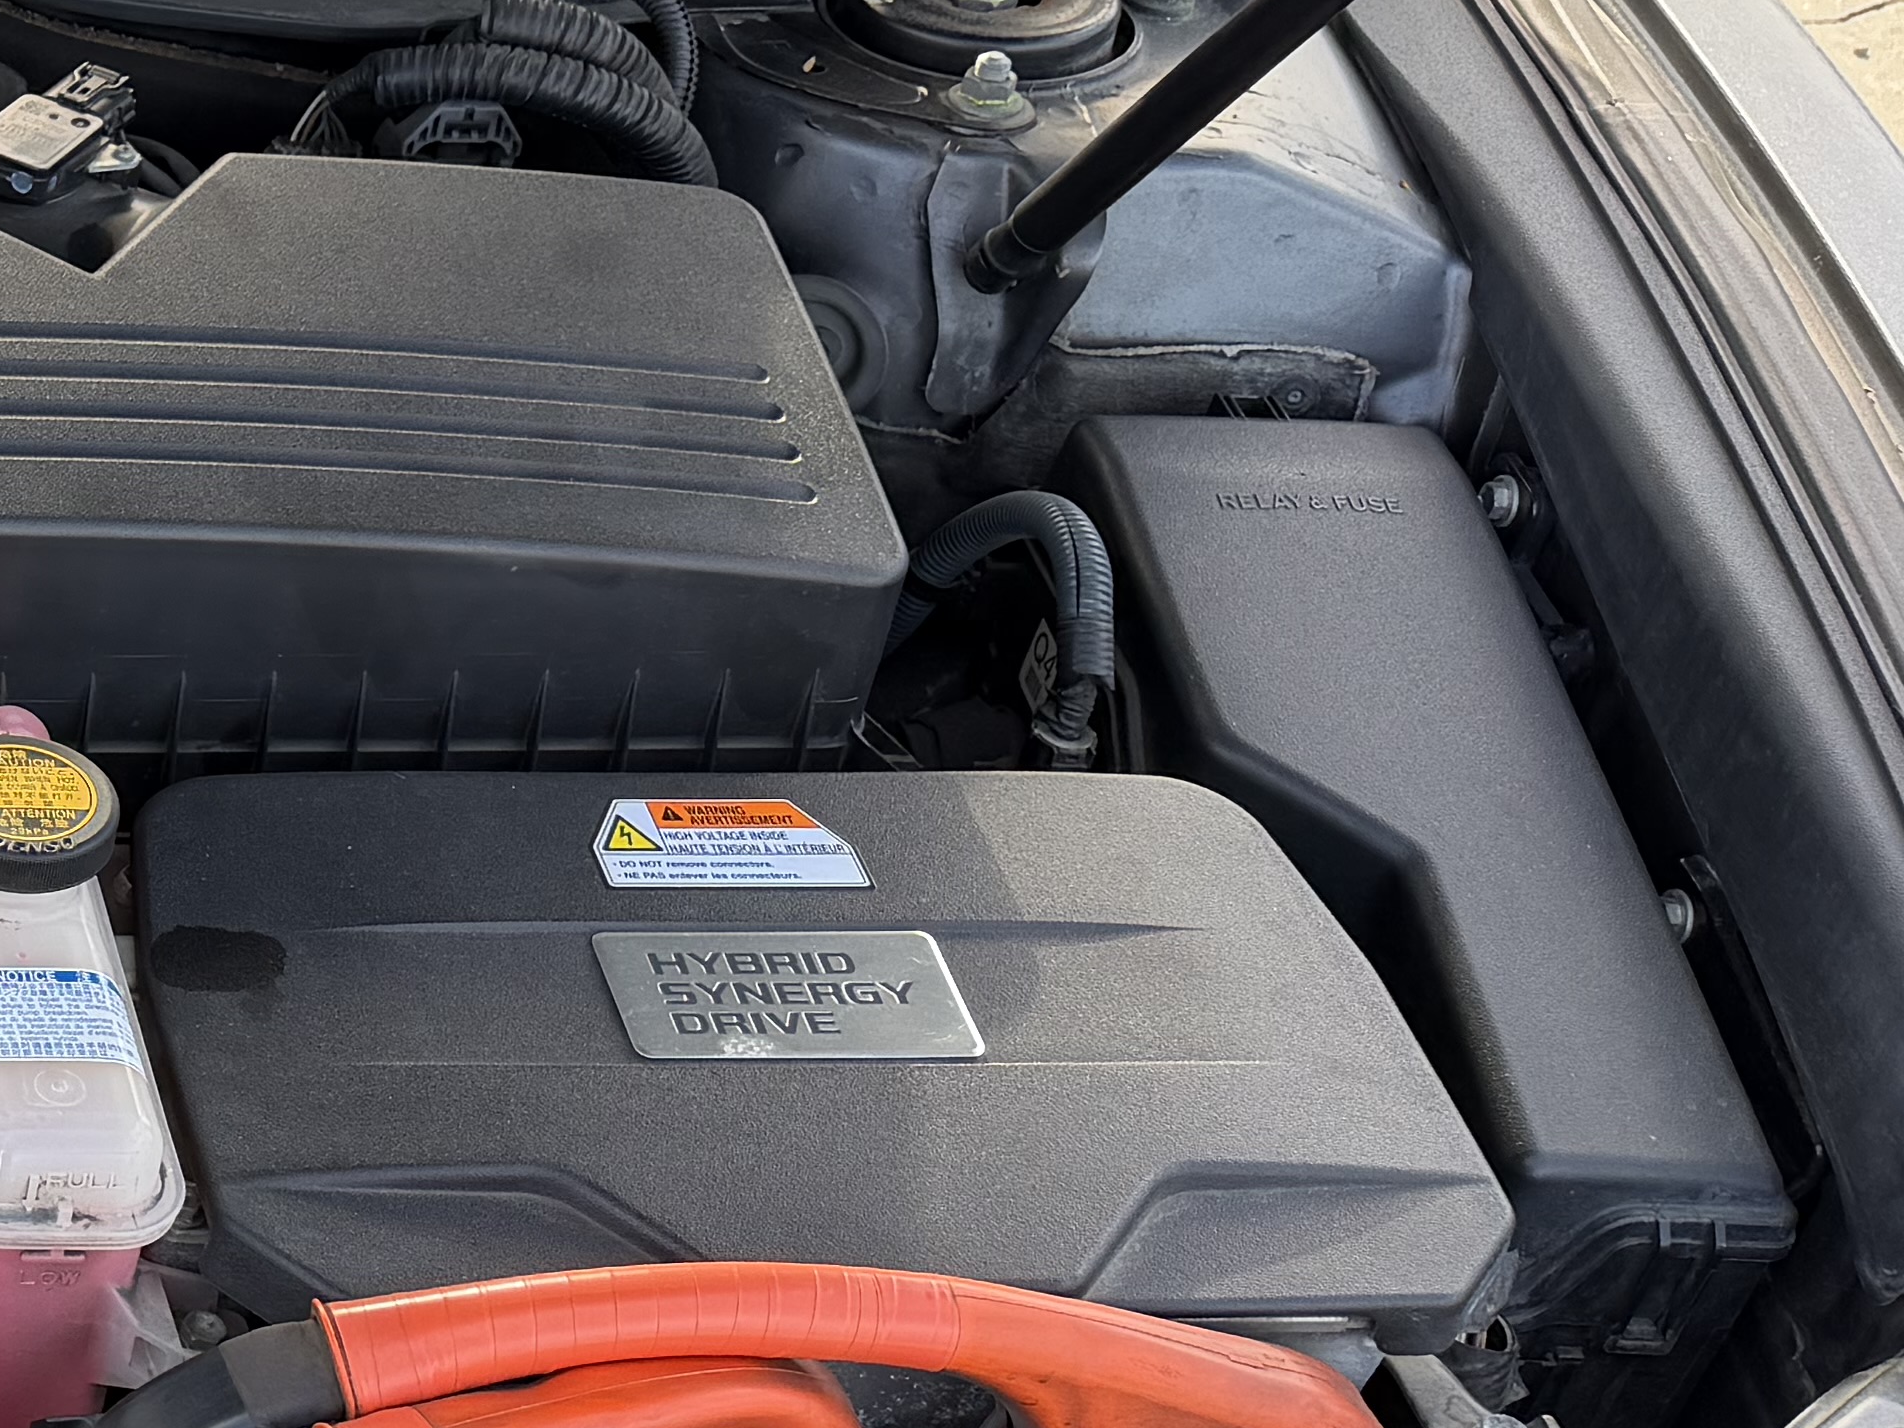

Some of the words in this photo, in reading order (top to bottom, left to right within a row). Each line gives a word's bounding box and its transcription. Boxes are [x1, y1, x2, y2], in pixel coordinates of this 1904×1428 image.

[1215, 492, 1302, 510] RELAY
[1308, 493, 1328, 510] &
[1331, 494, 1405, 514] FUSE
[0, 808, 77, 820] ATTENTION
[683, 805, 747, 816] WARNING
[690, 815, 795, 825] AVERTISSEMENT
[664, 830, 693, 841] HIGH
[695, 830, 748, 841] VOLTAGE
[749, 830, 789, 841] INSIDE
[668, 843, 708, 855] HAUTE
[710, 843, 761, 855] TENSION
[619, 860, 637, 869] DO
[640, 860, 663, 869] NOT
[666, 861, 707, 869] remove
[710, 860, 775, 869] connectors.
[624, 871, 641, 880] NE
[643, 871, 667, 880] PAS
[669, 871, 709, 880] enlever
[712, 871, 729, 880] les
[732, 872, 803, 881] connecteurs.
[645, 951, 856, 976] HYBRID
[657, 980, 915, 1006] SYNERGY
[670, 1010, 842, 1036] DRIVE
[45, 1171, 126, 1190] FULL
[19, 1268, 81, 1286] LOW
